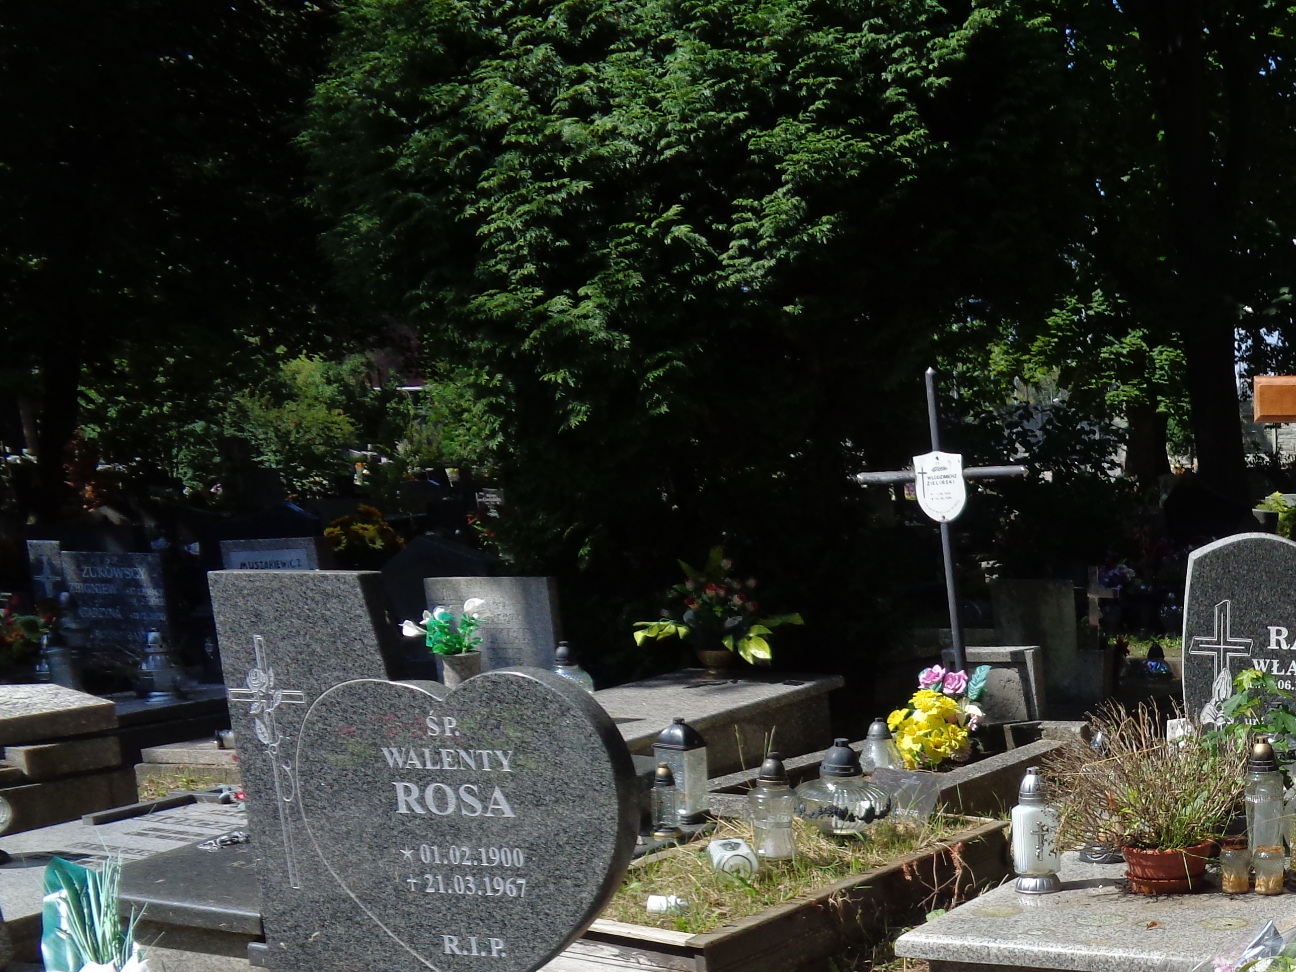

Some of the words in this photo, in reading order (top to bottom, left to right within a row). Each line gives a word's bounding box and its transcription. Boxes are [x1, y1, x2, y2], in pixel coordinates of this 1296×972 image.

[380, 747, 514, 773] WALENTY
[391, 781, 518, 818] ROSA
[419, 844, 526, 868] 01.02.1900
[423, 873, 528, 898] 21.03.1967
[441, 934, 508, 958] R.I.P.
